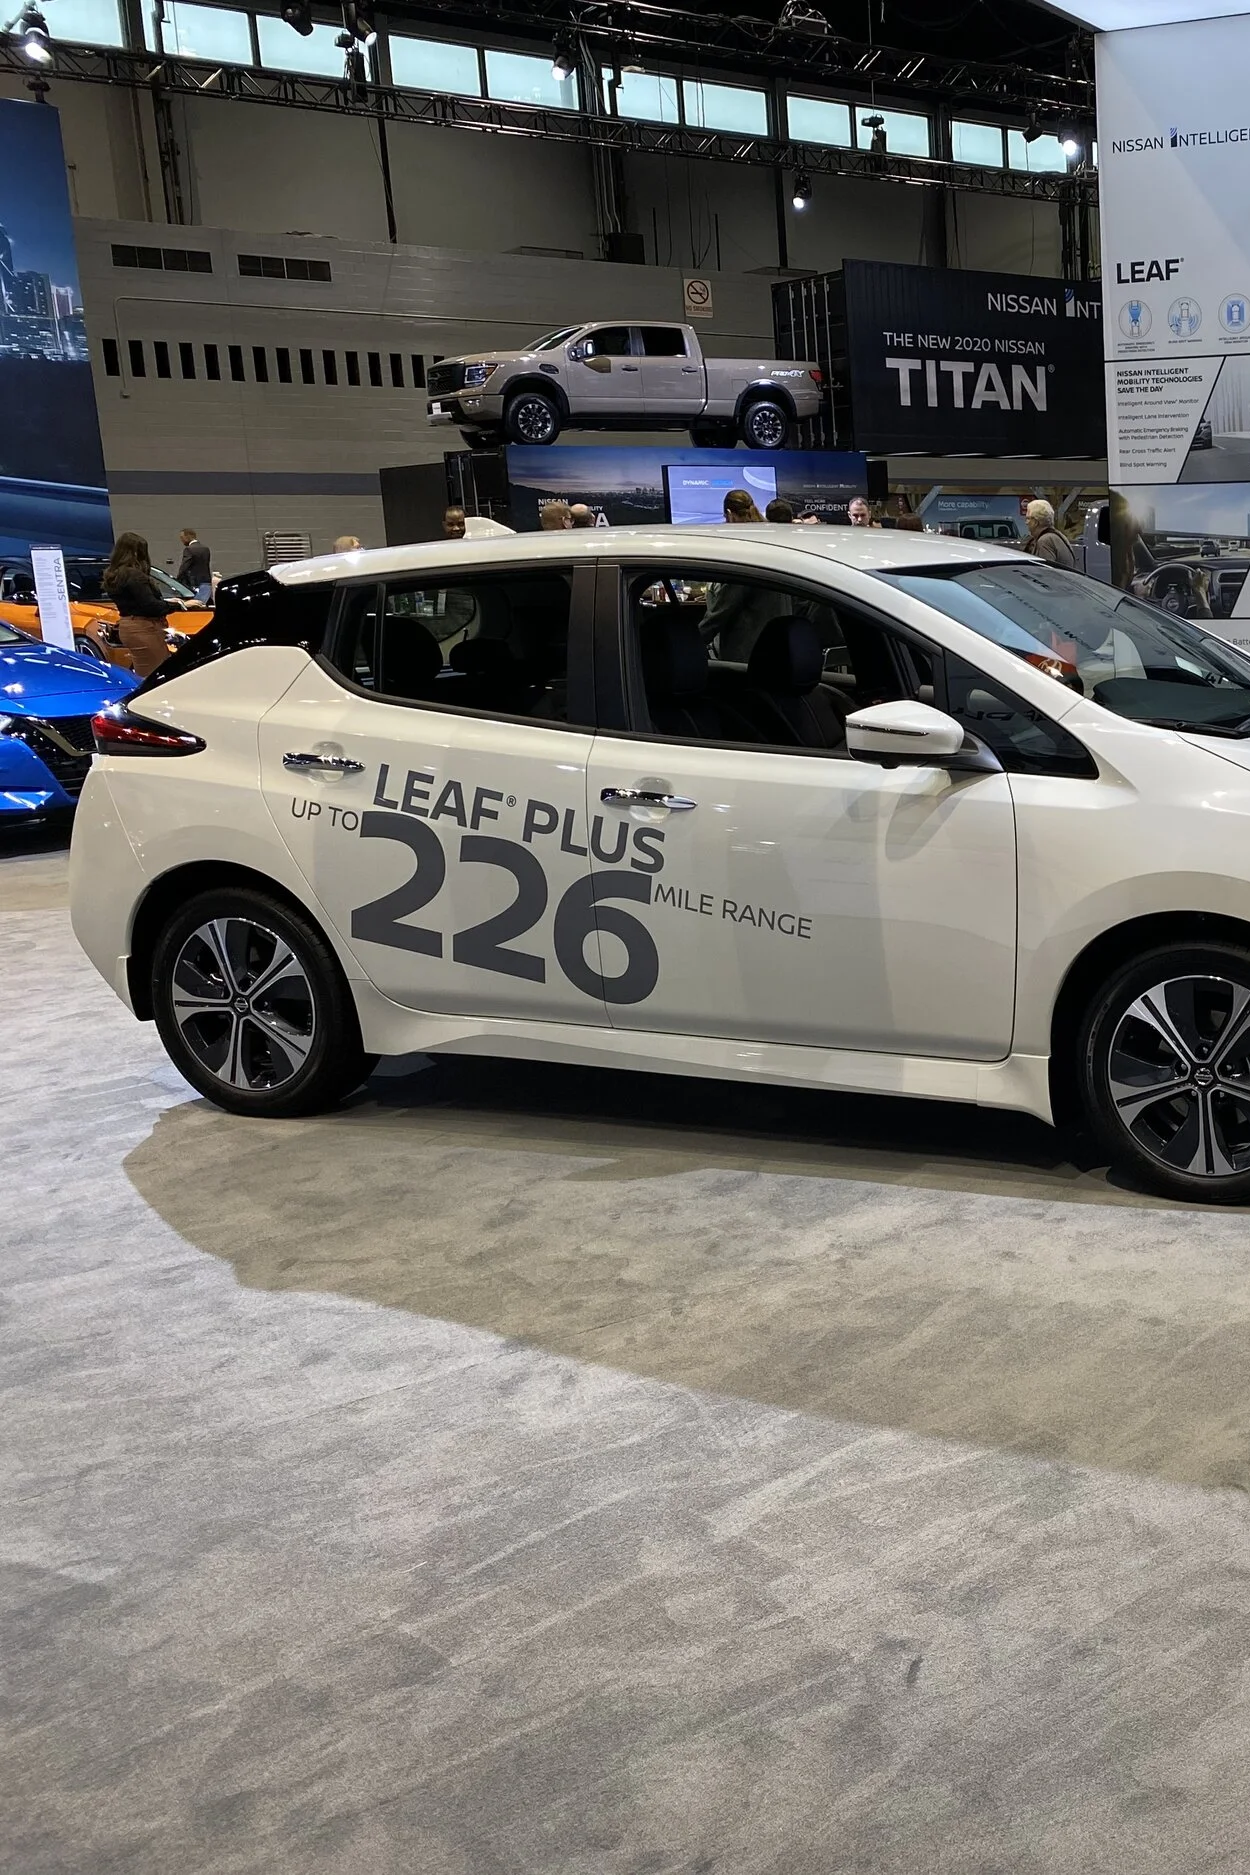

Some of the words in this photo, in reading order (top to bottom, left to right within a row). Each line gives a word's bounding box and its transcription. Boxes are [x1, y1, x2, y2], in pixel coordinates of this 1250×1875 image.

[1112, 136, 1164, 154] NISSAN
[986, 292, 1057, 317] NISSAN
[882, 331, 913, 347] THE
[917, 333, 951, 350] NEW
[954, 336, 991, 352] 2020
[994, 338, 1045, 355] NISSAN
[1117, 369, 1143, 377] NISSAN
[1144, 367, 1189, 376] INTELLIGENT
[1117, 378, 1150, 386] MOBILITY
[1151, 375, 1203, 384] TECHNOLOGIES
[1149, 385, 1164, 393] DAY
[54, 557, 66, 601] SENTRA
[290, 797, 323, 820] UP
[328, 806, 360, 832] TO
[522, 799, 667, 873] PLUS
[350, 810, 660, 1005] 226
[653, 882, 714, 916] MILE
[720, 899, 814, 940] RANGE
